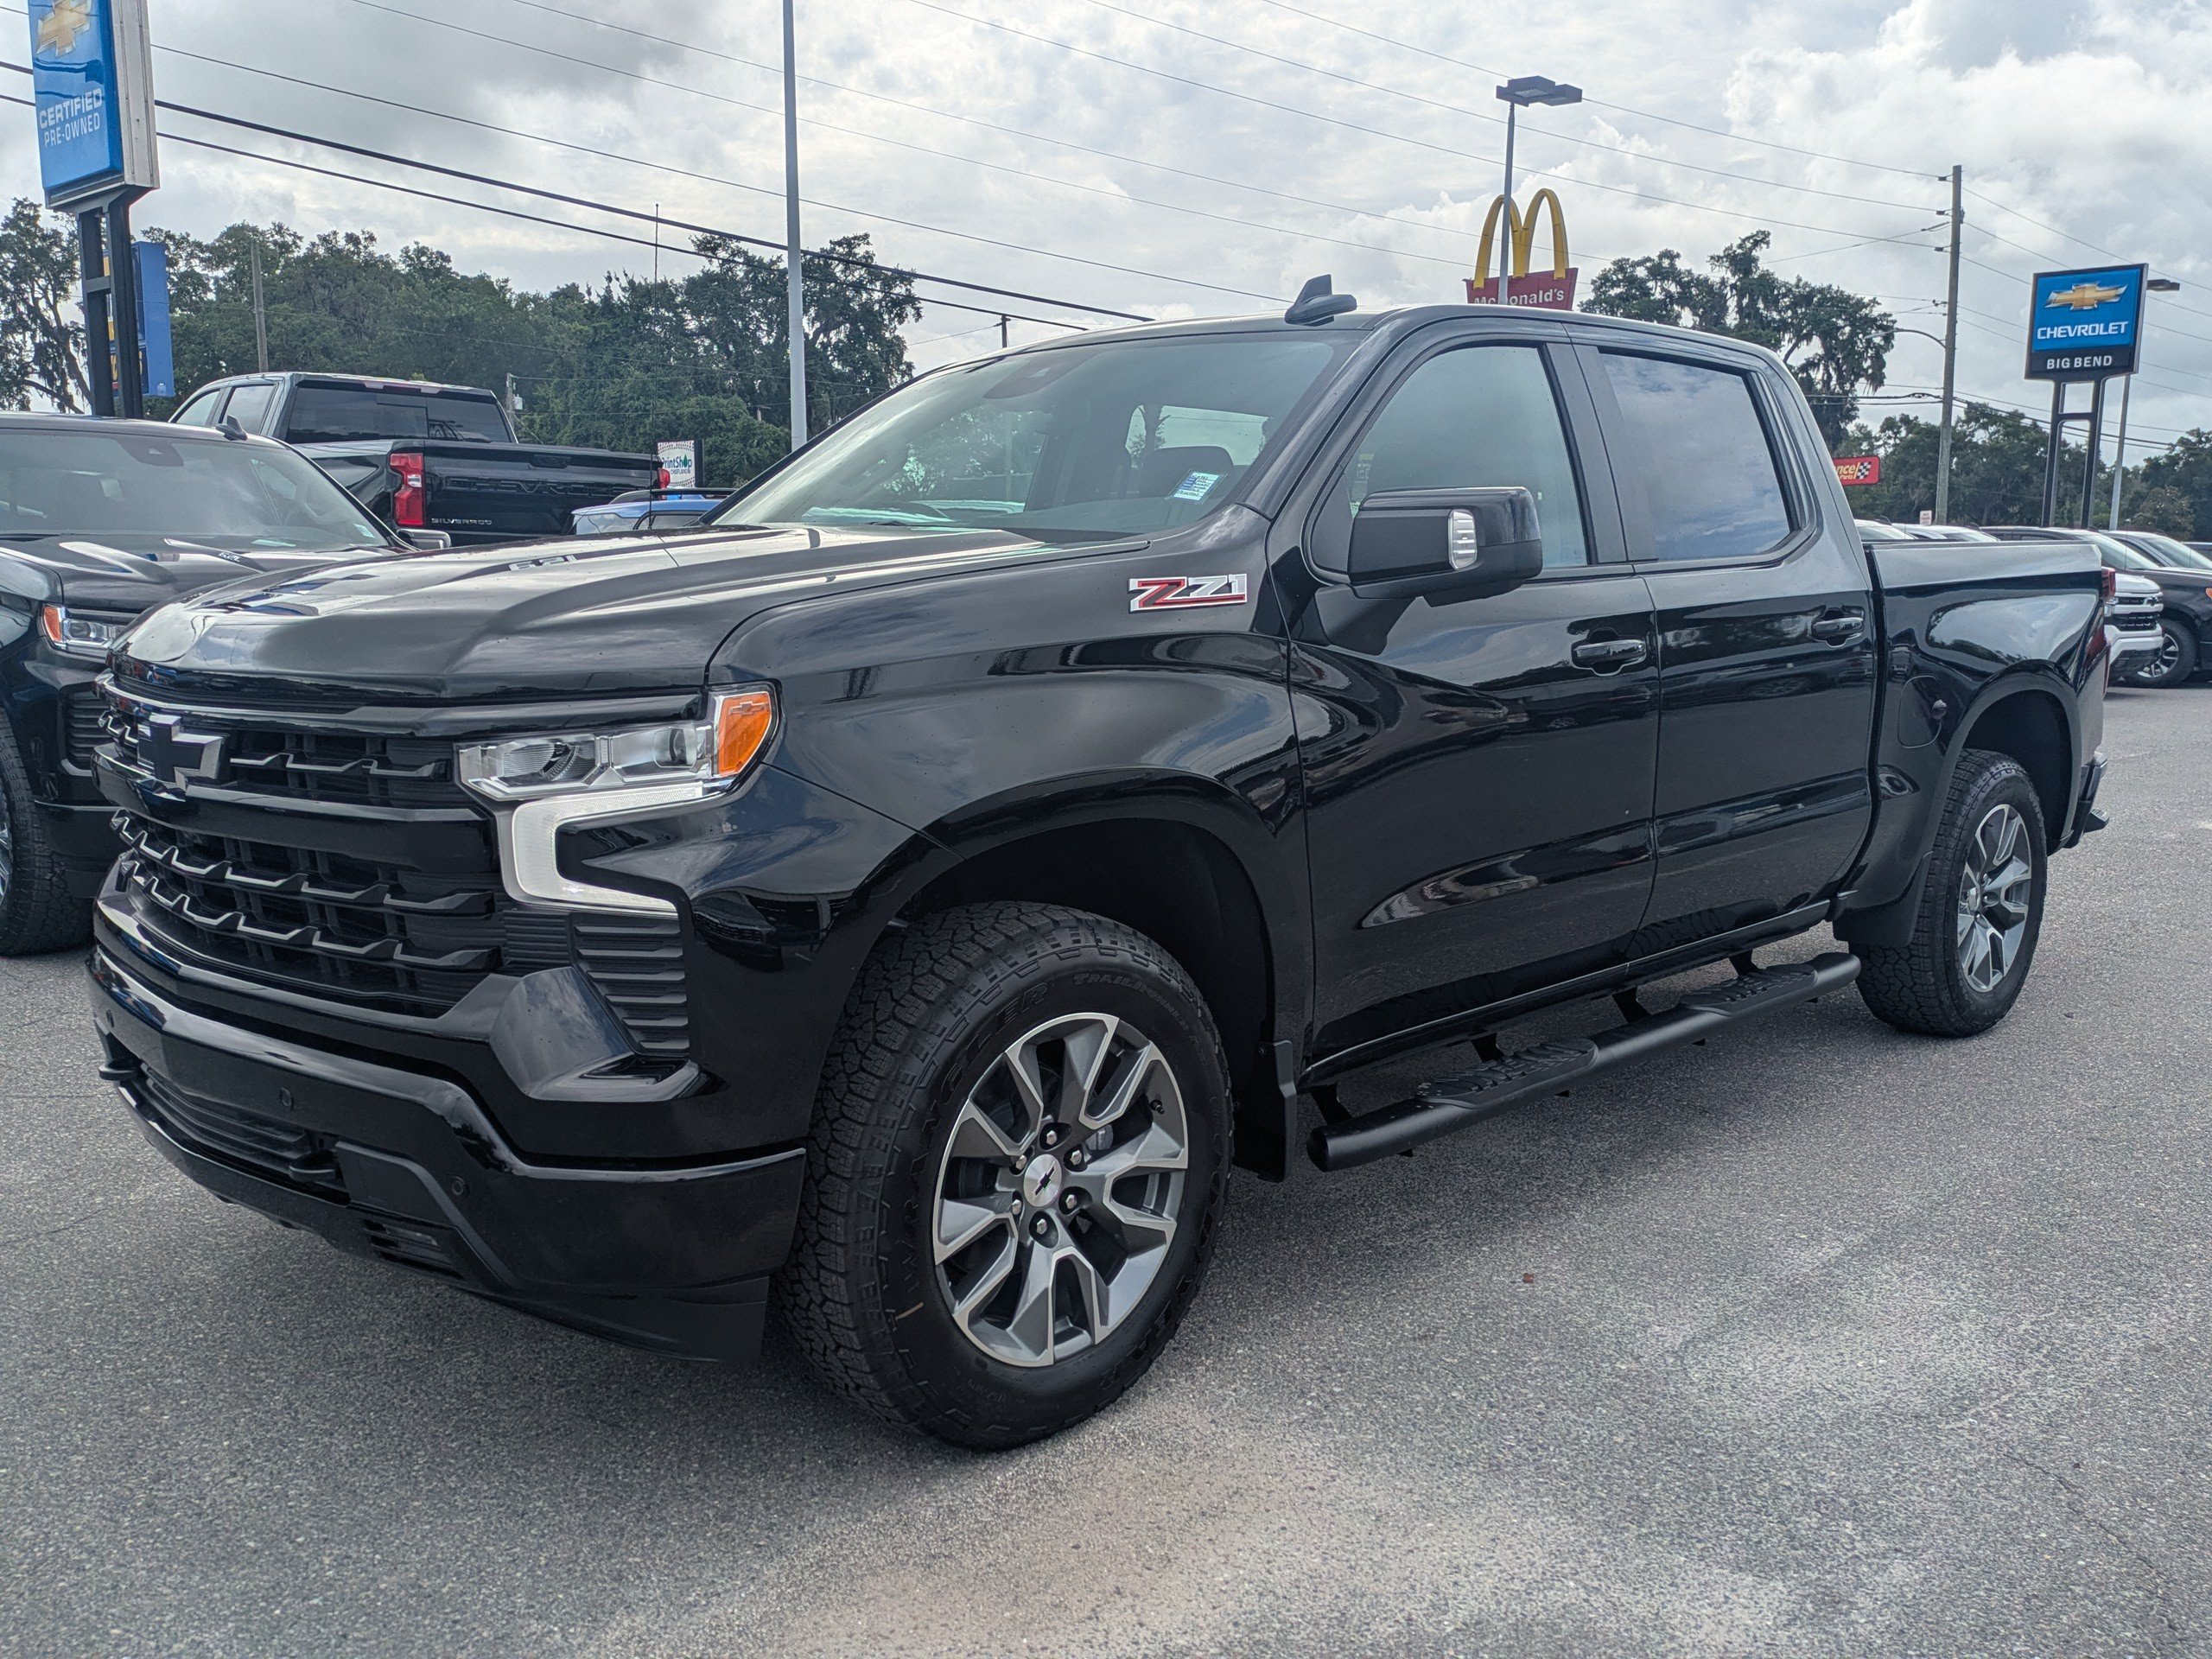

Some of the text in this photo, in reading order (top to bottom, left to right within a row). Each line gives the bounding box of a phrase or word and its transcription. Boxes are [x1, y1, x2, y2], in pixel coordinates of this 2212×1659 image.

[40, 87, 103, 129] CERTIFIED
[44, 111, 100, 148] PRE-OWNED
[1474, 289, 1565, 305] Mconald's
[2037, 321, 2129, 340] CHEVROLET
[2046, 355, 2113, 370] BIG BEND
[1128, 573, 1248, 612] Z71
